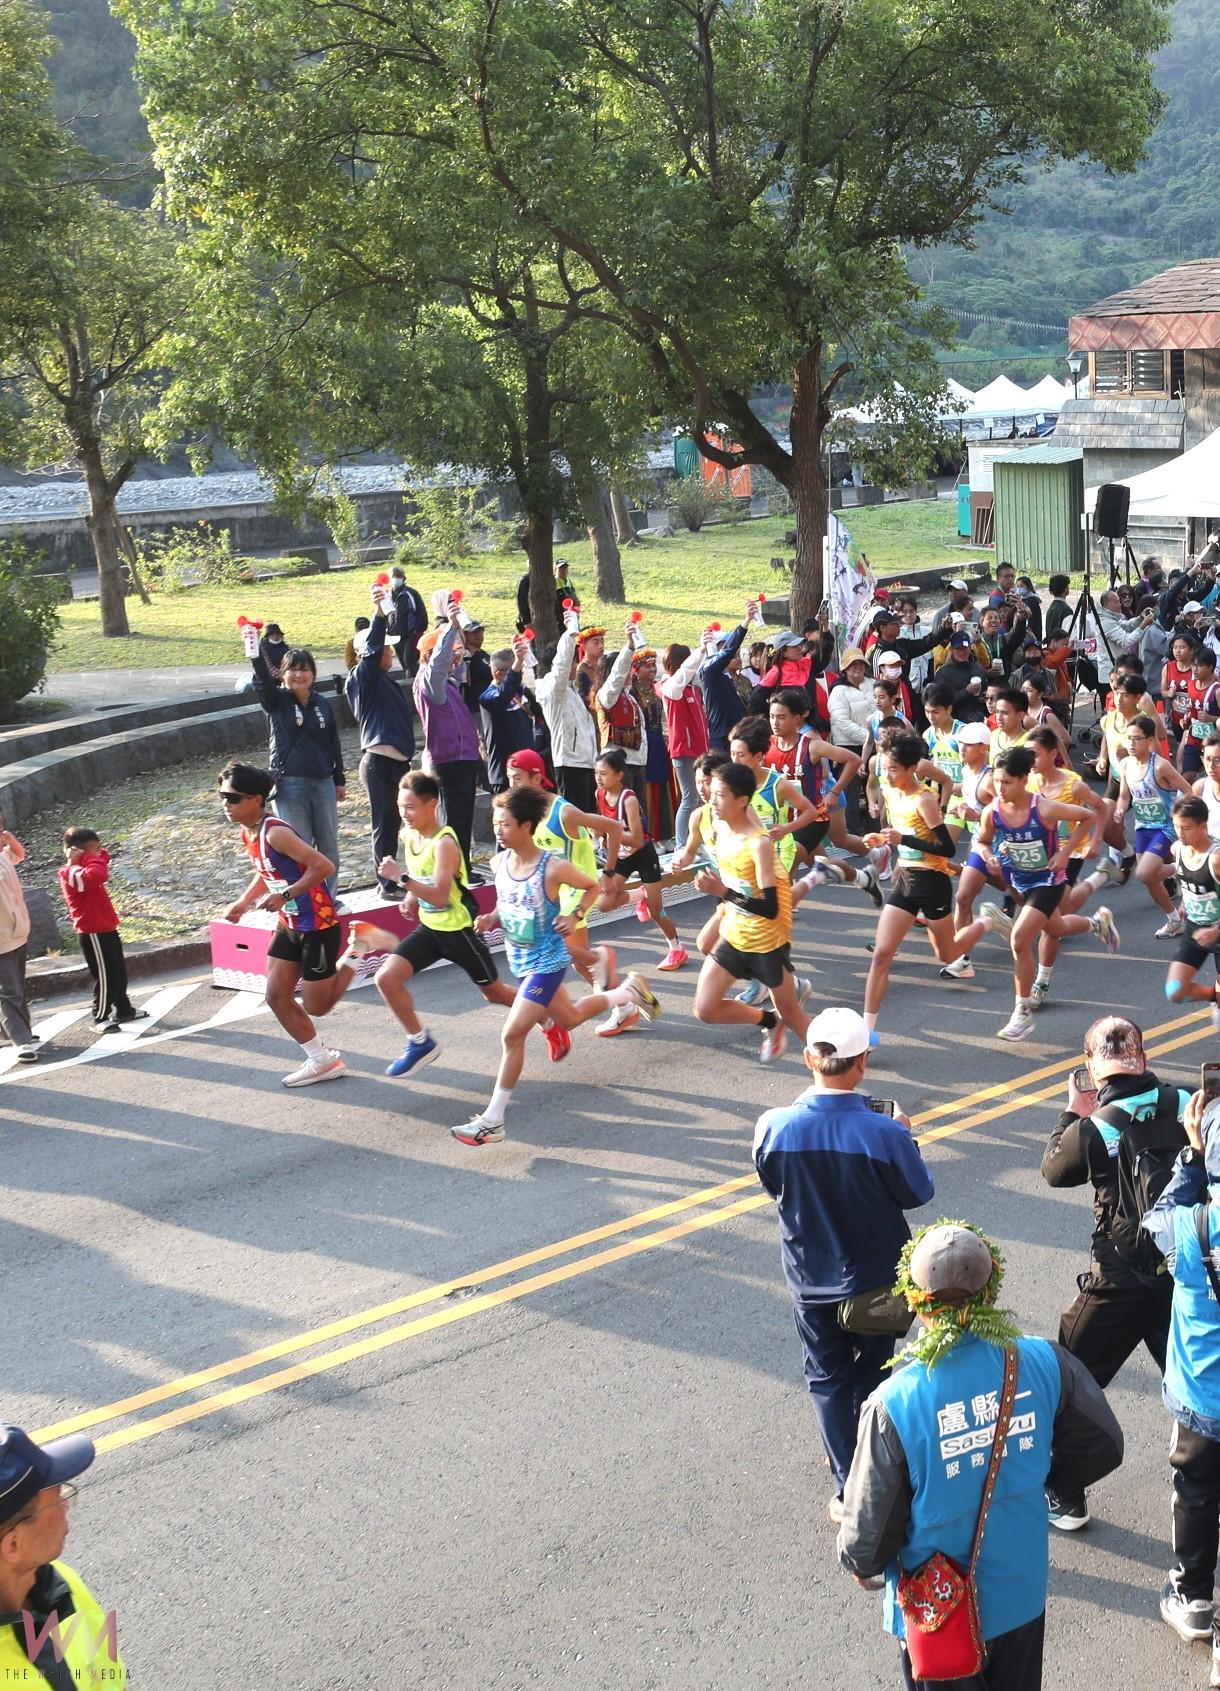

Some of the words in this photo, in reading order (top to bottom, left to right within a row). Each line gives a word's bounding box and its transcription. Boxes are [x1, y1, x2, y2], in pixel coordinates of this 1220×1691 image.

[1136, 803, 1160, 816] 342
[1010, 848, 1041, 863] 325
[505, 915, 528, 936] 37
[937, 1390, 1032, 1438] 盧縣一
[945, 1436, 1034, 1480] 服務隊
